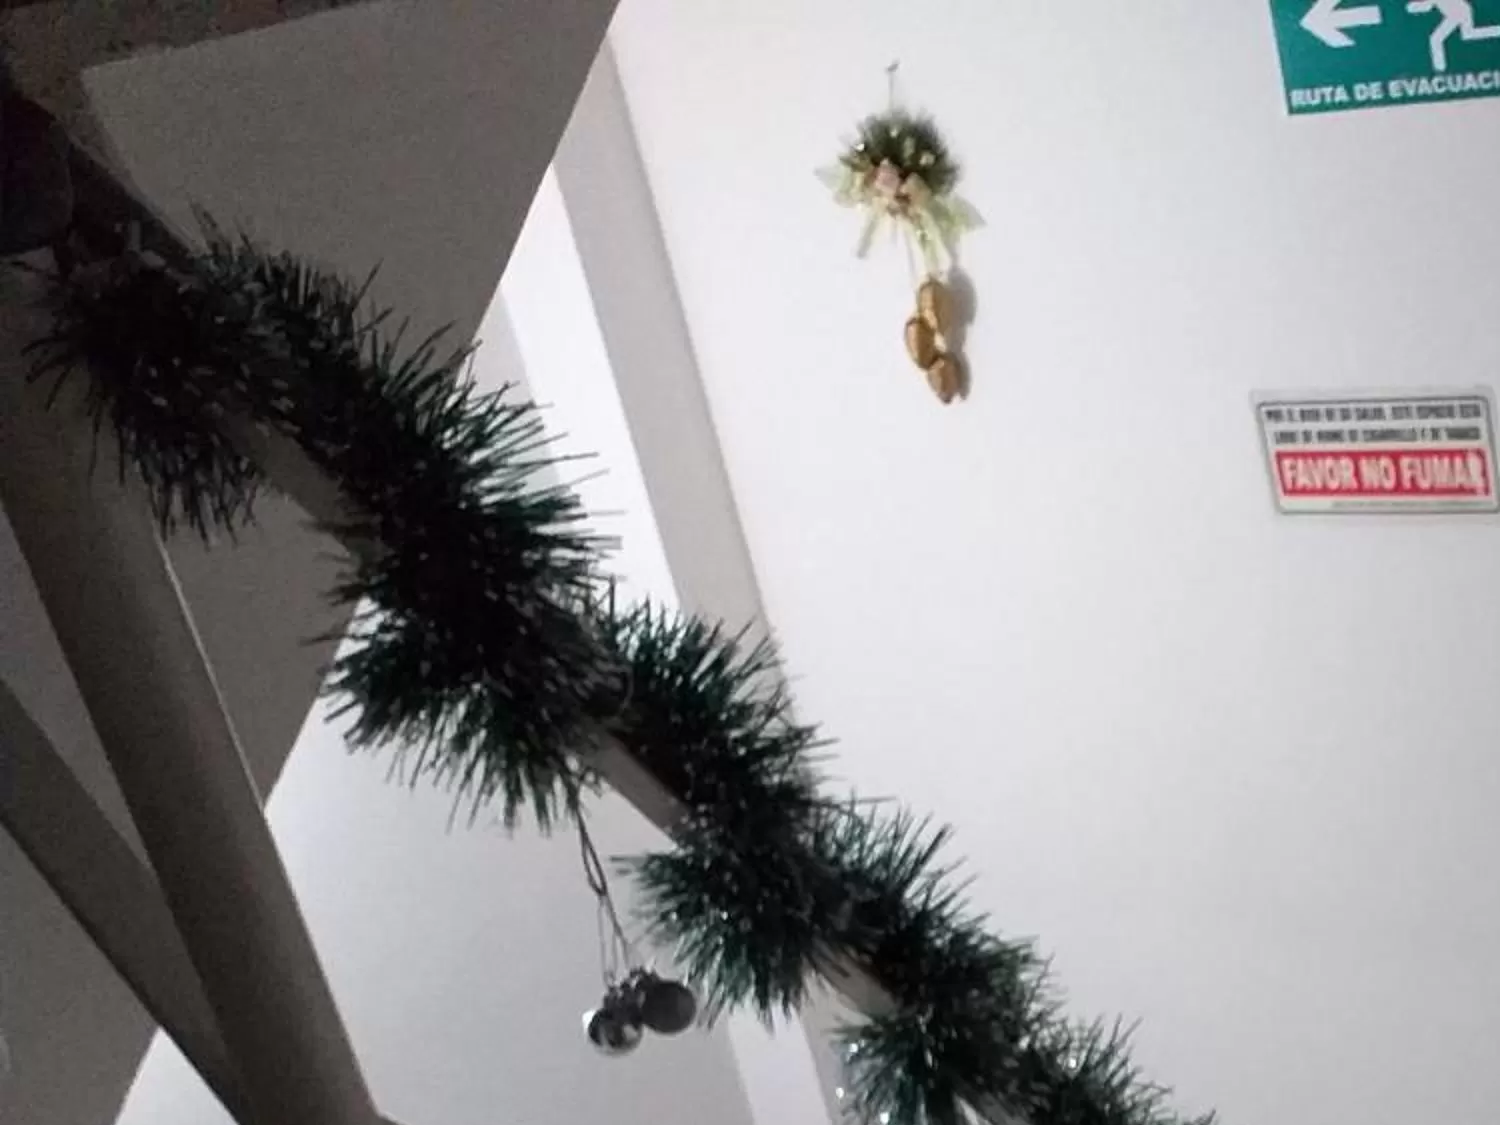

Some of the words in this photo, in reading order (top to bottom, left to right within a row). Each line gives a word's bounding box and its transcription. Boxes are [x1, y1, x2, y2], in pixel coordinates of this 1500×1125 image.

[1290, 86, 1349, 107] RUTA
[1353, 82, 1384, 101] DE
[1281, 456, 1358, 492] FAVOR
[1359, 456, 1397, 490] NO
[1400, 452, 1484, 491] FUMAR
